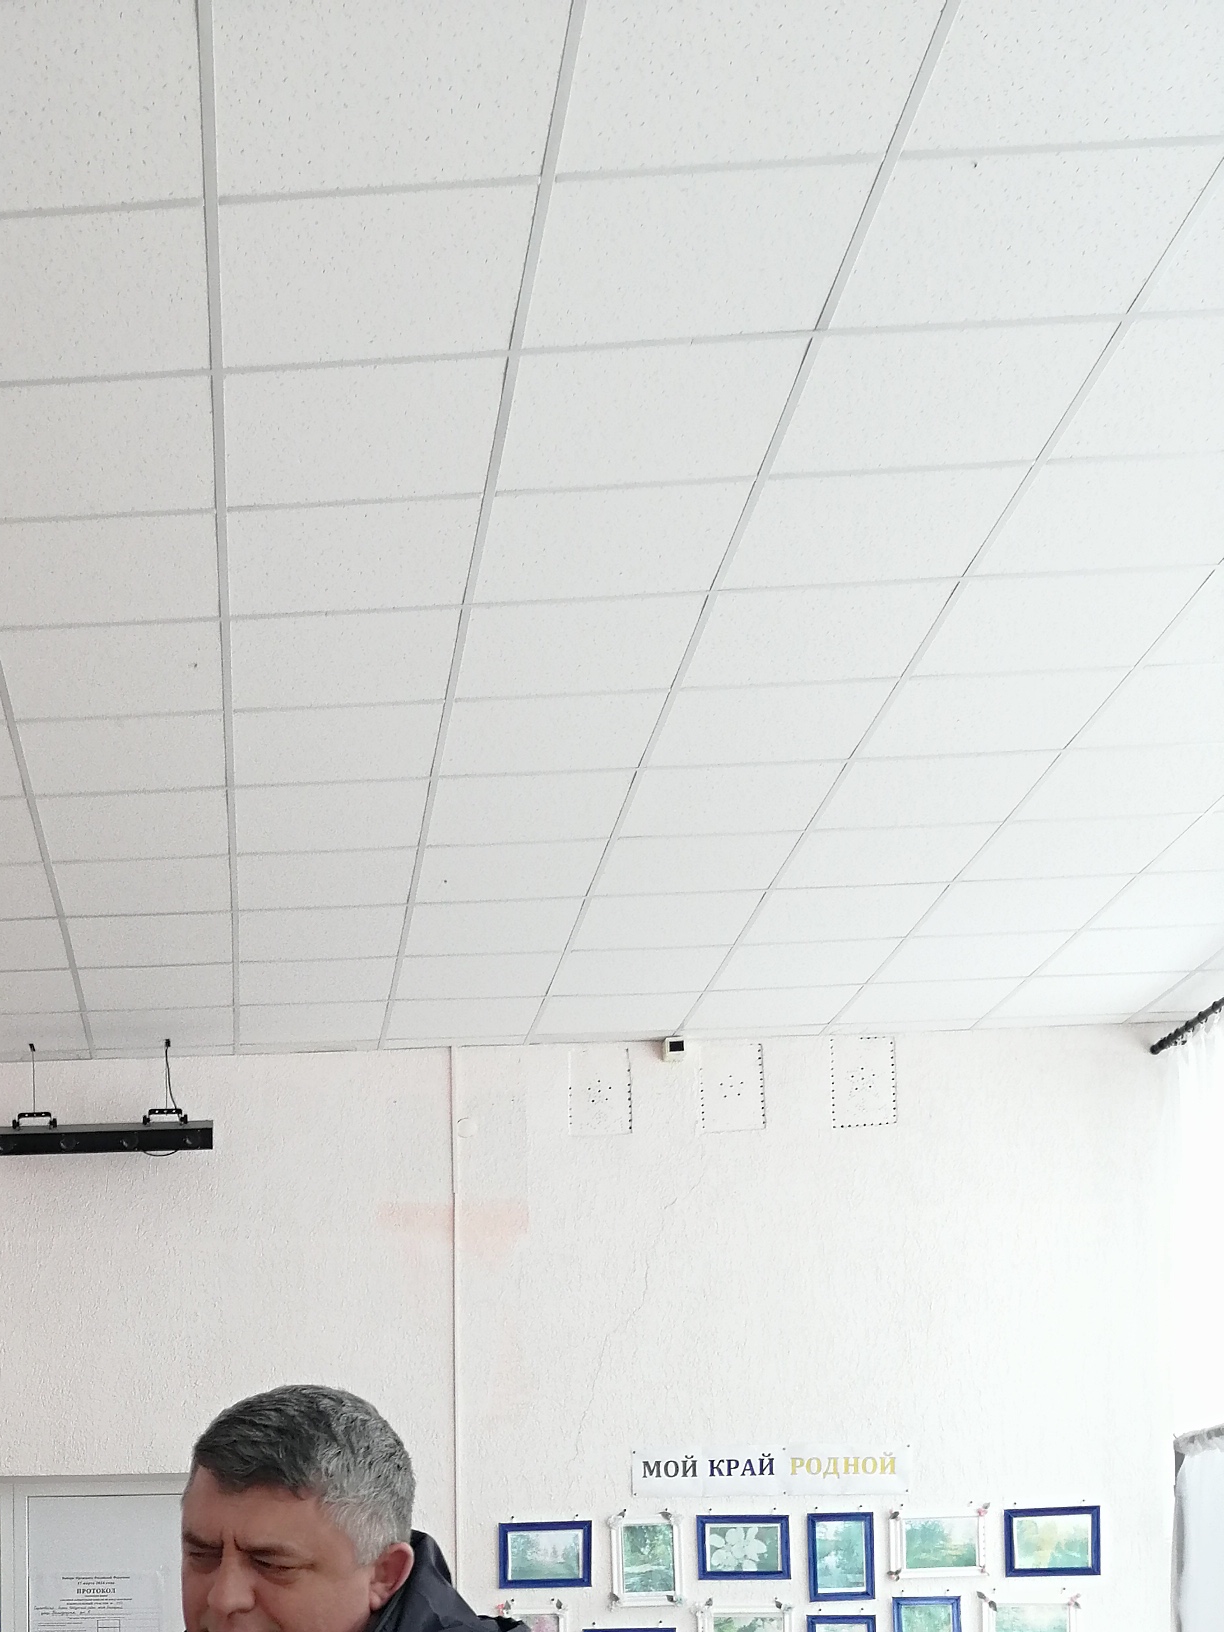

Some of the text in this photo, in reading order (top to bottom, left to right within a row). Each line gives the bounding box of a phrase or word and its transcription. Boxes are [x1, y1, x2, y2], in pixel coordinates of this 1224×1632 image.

[642, 1452, 897, 1479] МОЙ КРАЙ РОДНОЙ
